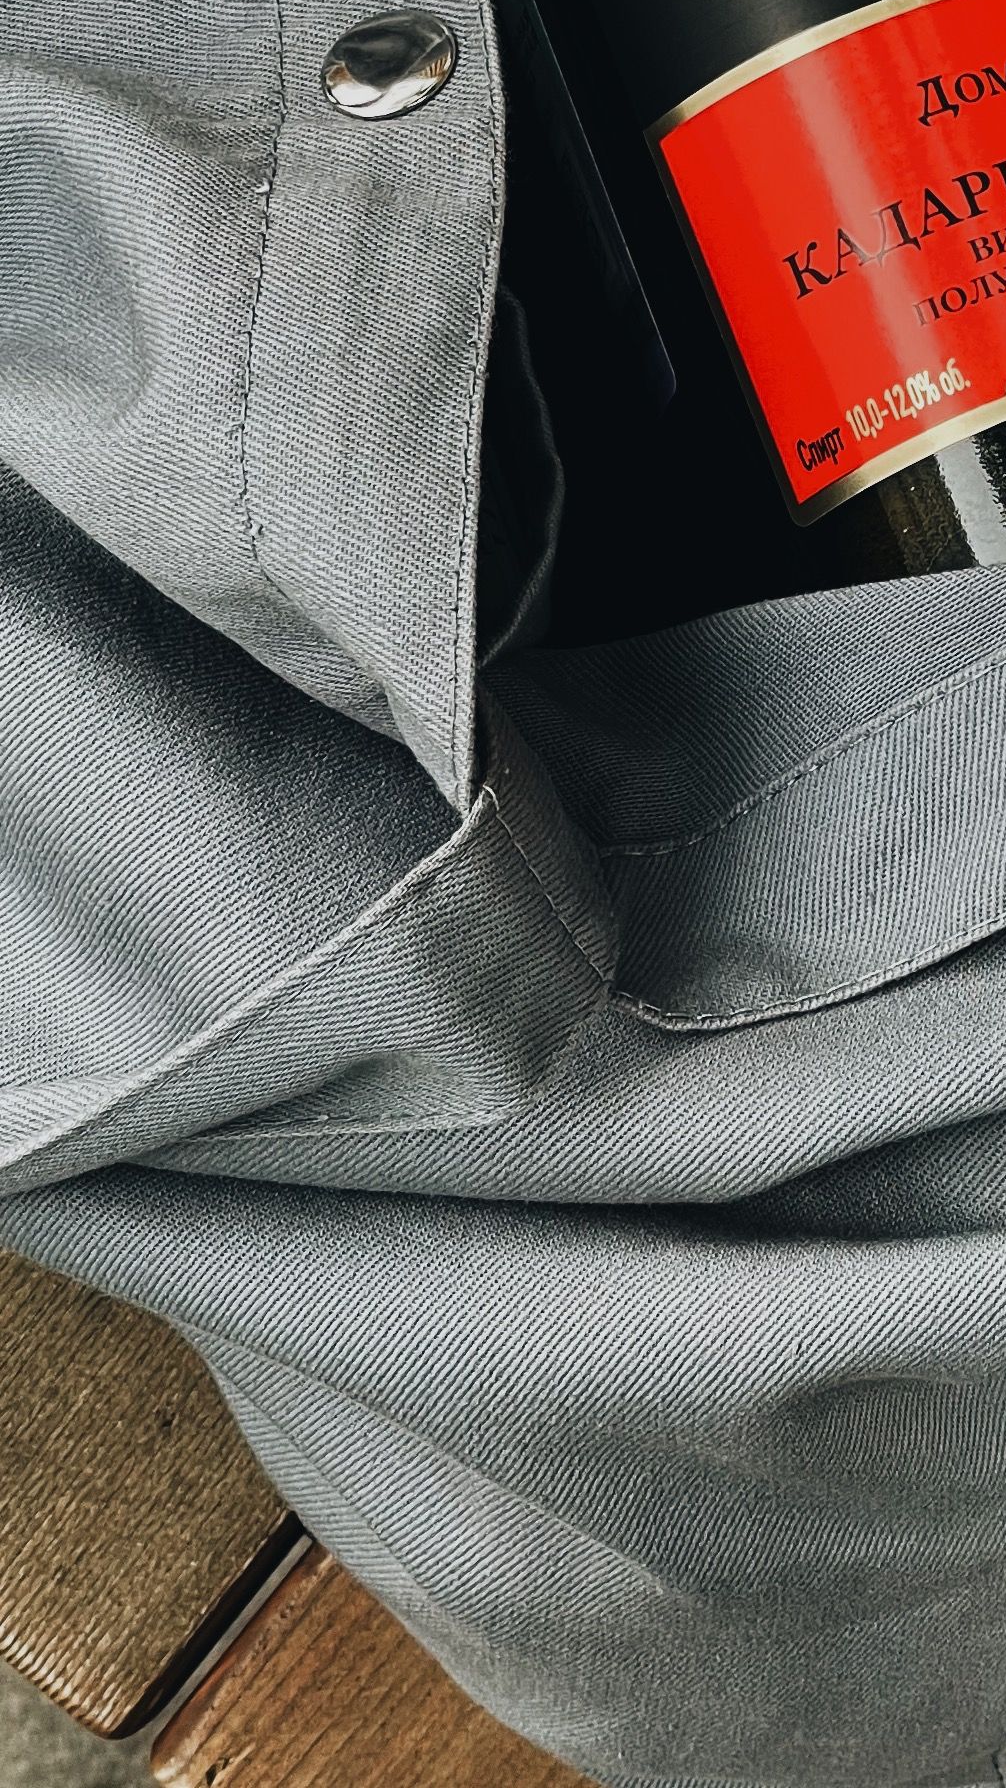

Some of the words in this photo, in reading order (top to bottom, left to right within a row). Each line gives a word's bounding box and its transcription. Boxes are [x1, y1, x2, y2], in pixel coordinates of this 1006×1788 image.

[796, 426, 845, 471] Спирт
[845, 369, 942, 442] 10,0-12,0%
[938, 357, 972, 396] об.
